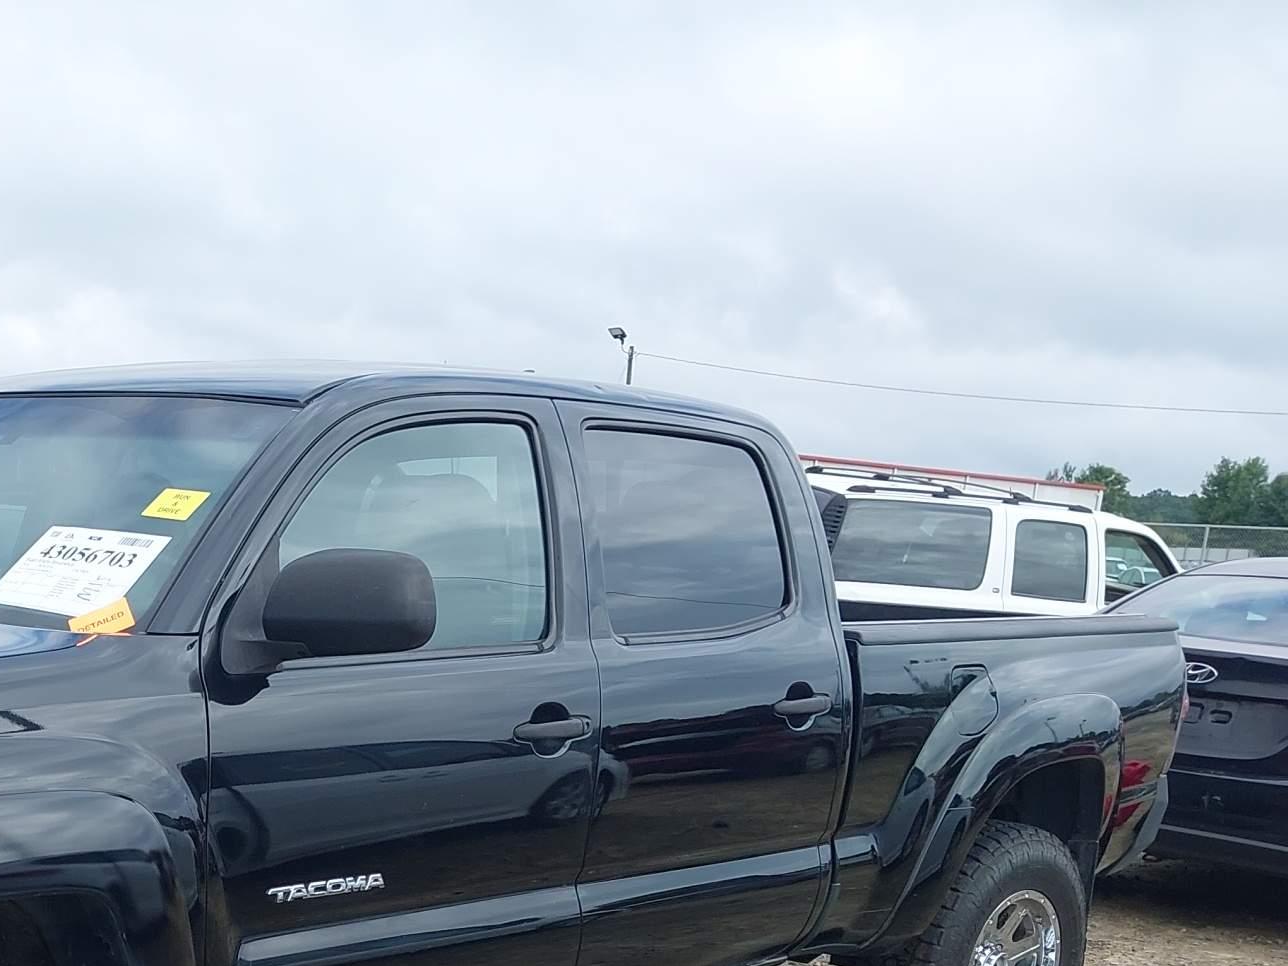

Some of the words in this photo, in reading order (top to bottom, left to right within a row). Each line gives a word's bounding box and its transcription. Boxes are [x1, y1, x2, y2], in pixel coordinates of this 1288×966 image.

[39, 544, 138, 569] 43056703
[78, 610, 125, 632] DETAILED
[265, 873, 386, 904] TACOMA
